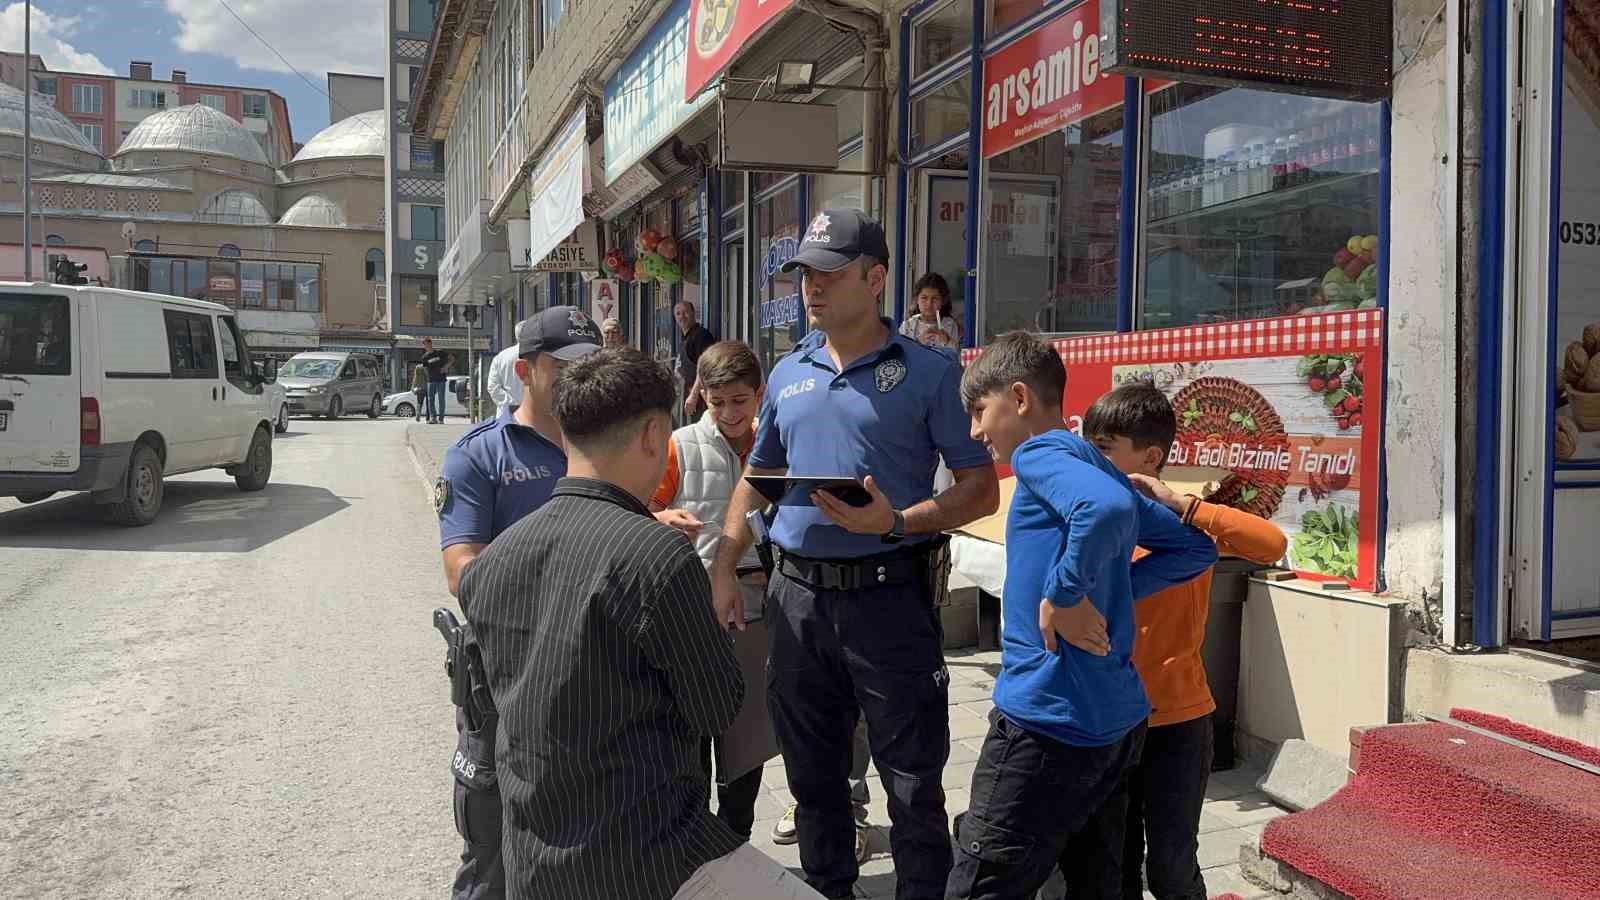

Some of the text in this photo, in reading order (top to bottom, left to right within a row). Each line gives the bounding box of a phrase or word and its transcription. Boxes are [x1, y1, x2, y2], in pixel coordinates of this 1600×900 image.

[987, 20, 1109, 129] arsamie
[1560, 221, 1600, 245] 053
[414, 245, 429, 270] Ş
[525, 244, 585, 263] KASİYE
[1167, 440, 1356, 475] Bu Tadı Bizimle Tanıdı
